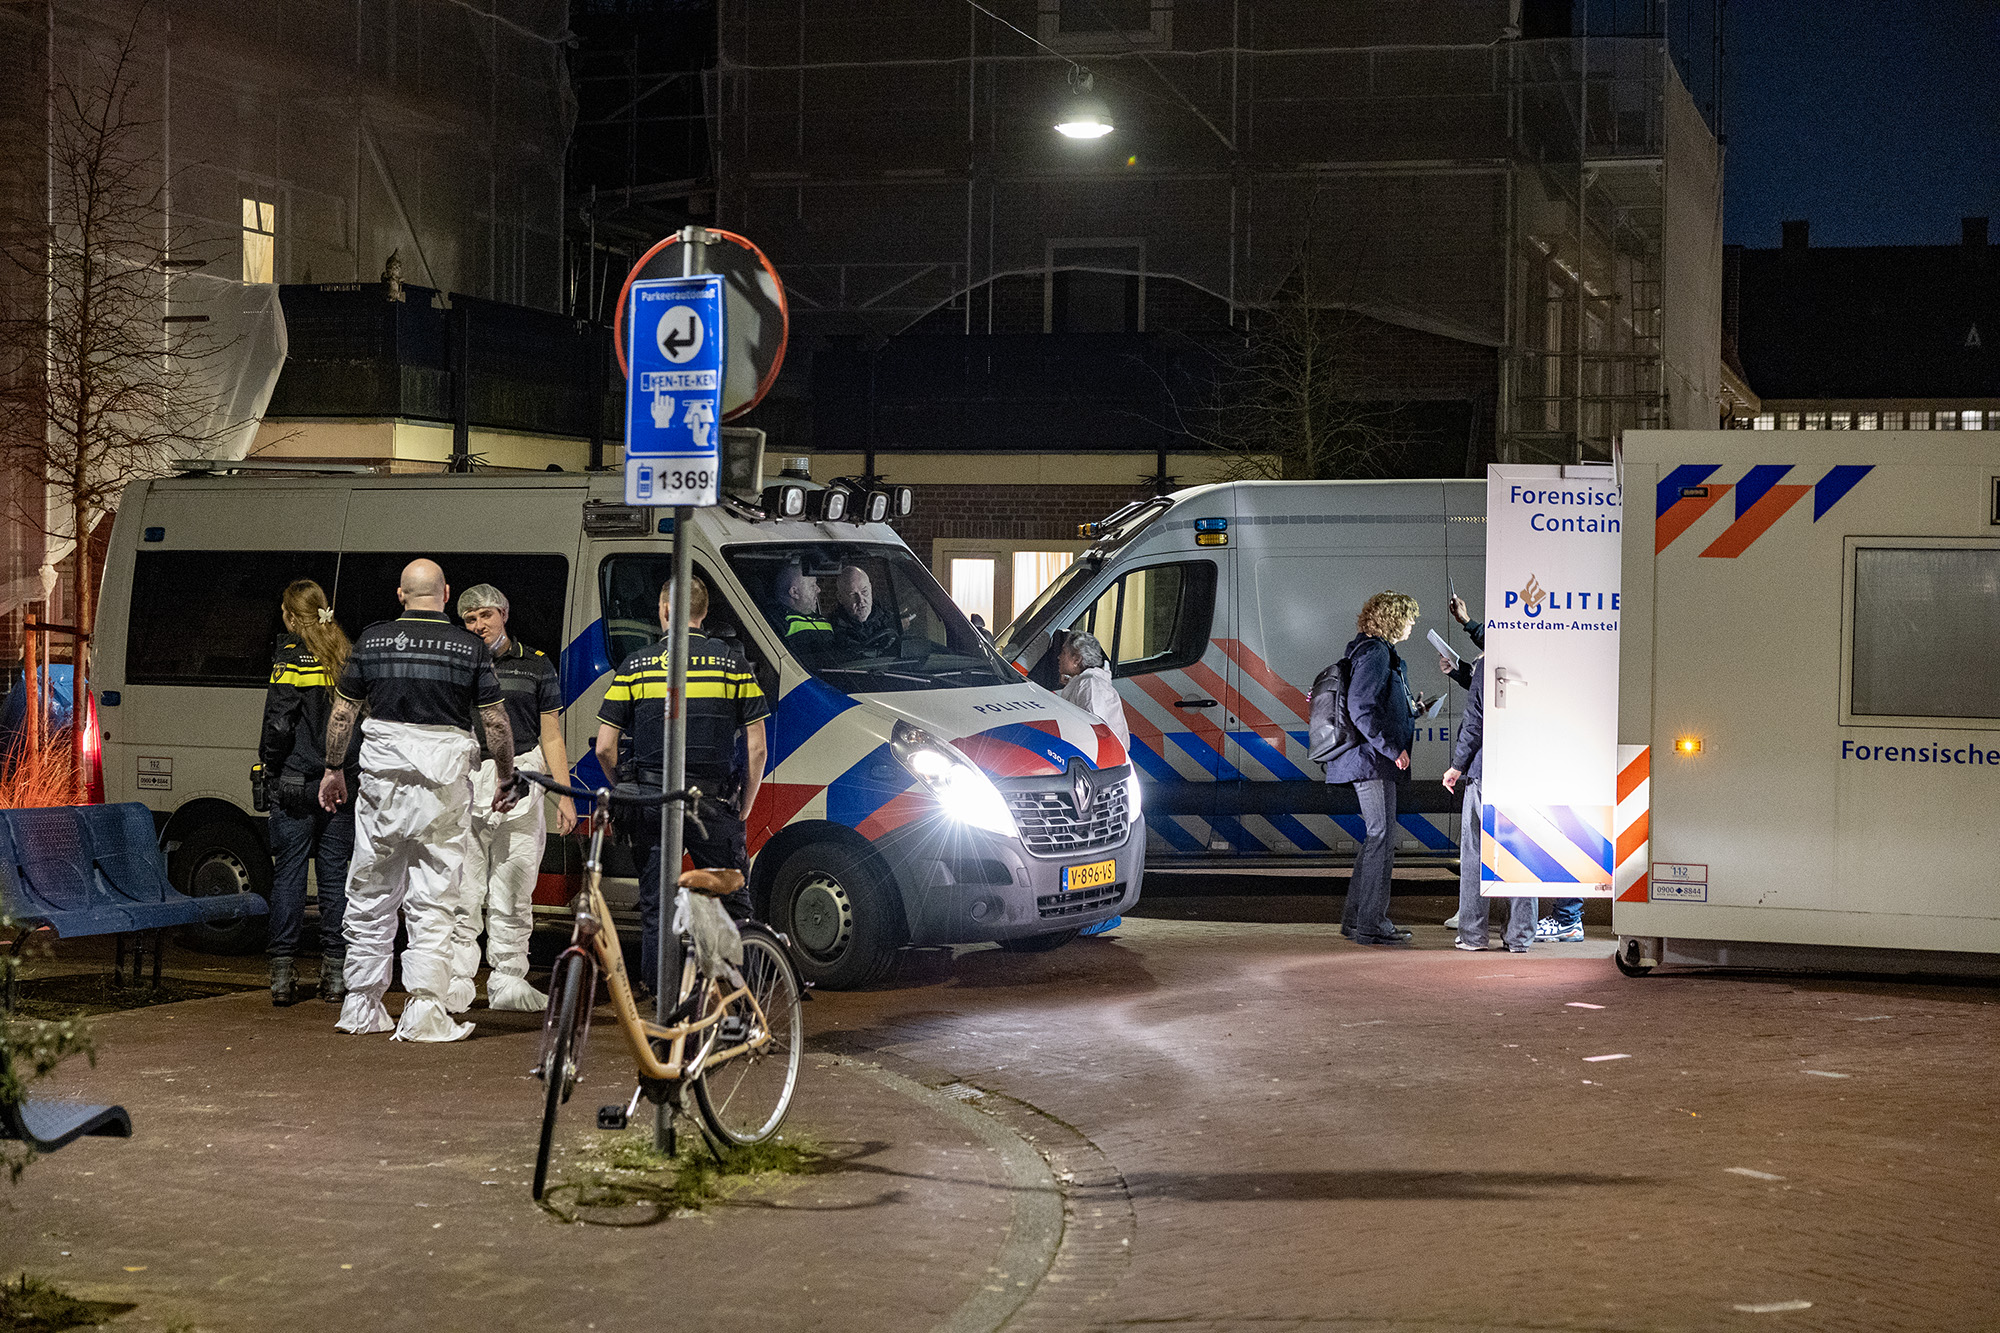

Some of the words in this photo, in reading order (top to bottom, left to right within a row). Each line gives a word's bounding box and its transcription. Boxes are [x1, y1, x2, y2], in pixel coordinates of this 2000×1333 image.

[1531, 513, 1620, 533] Contain
[1505, 591, 1620, 617] POLITIE
[385, 637, 452, 651] POLITIE
[651, 656, 716, 670] POTIE
[972, 701, 1046, 714] POLITIE
[1842, 740, 2000, 765] Forensische
[1071, 863, 1112, 886] V-896-VS
[1673, 866, 1688, 875] 112
